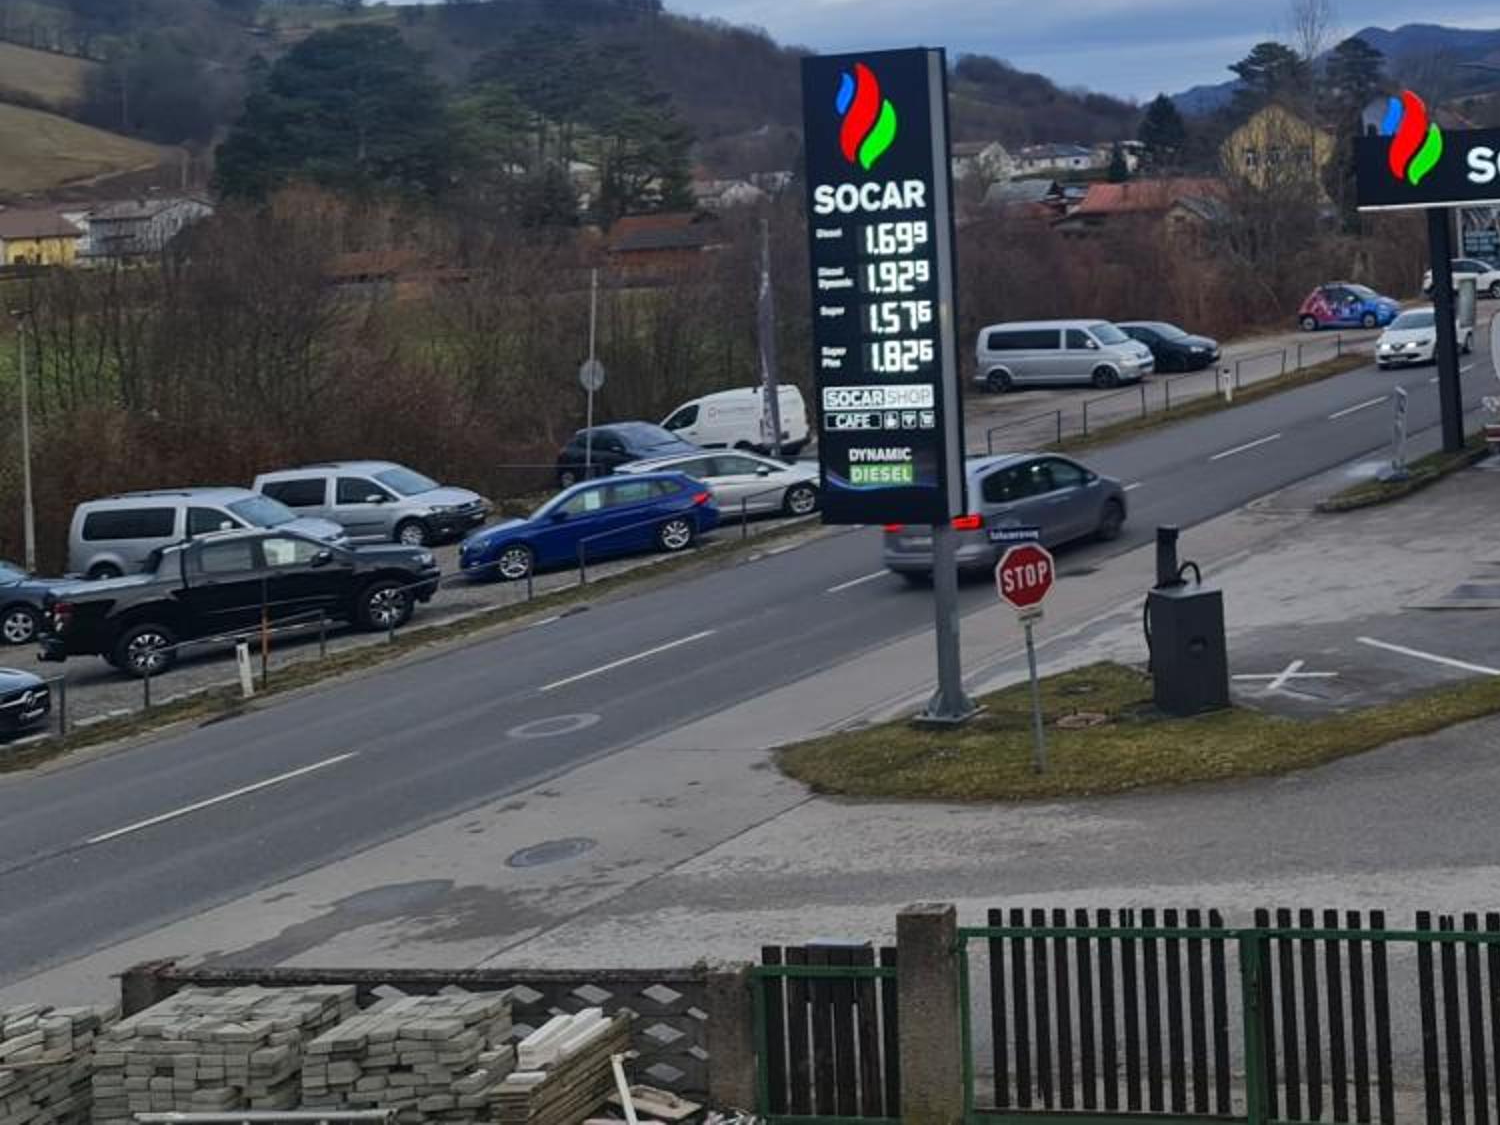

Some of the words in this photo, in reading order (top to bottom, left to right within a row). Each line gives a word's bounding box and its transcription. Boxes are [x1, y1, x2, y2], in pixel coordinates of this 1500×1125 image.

[814, 180, 926, 214] SOCAR
[849, 448, 912, 461] DYNAMIC
[851, 466, 912, 482] DIESEL
[1003, 561, 1048, 592] STOP
